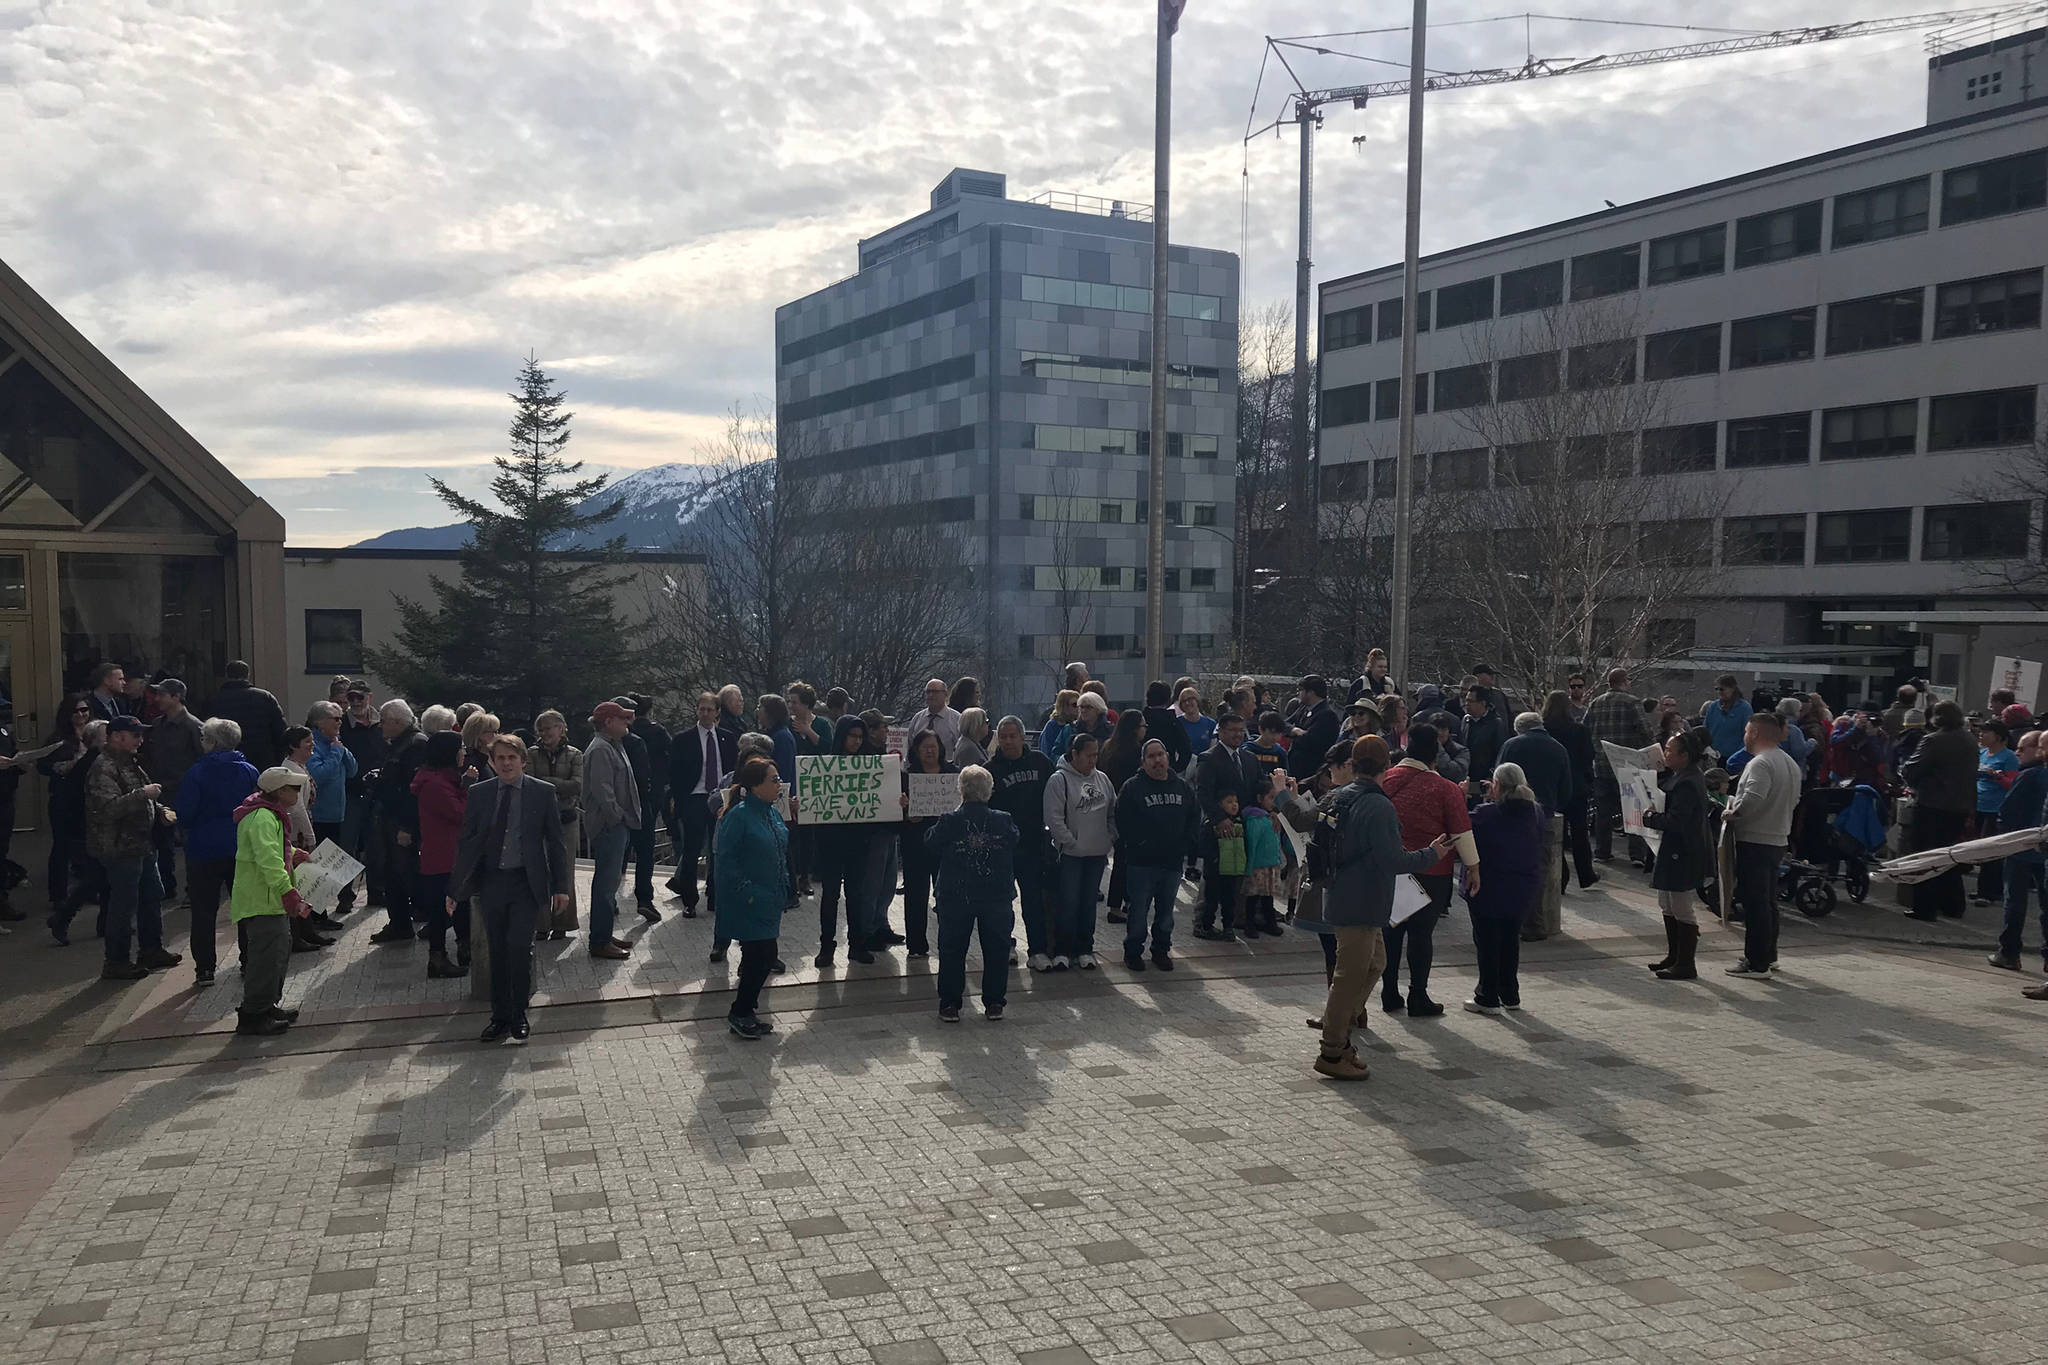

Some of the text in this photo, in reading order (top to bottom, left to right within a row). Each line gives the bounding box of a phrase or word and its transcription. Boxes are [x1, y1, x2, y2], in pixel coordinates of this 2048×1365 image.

[799, 754, 884, 775] SAVE OUR
[799, 772, 884, 797] FERRIES
[799, 792, 882, 812] SAVE OUR
[813, 806, 879, 822] TOWNS
